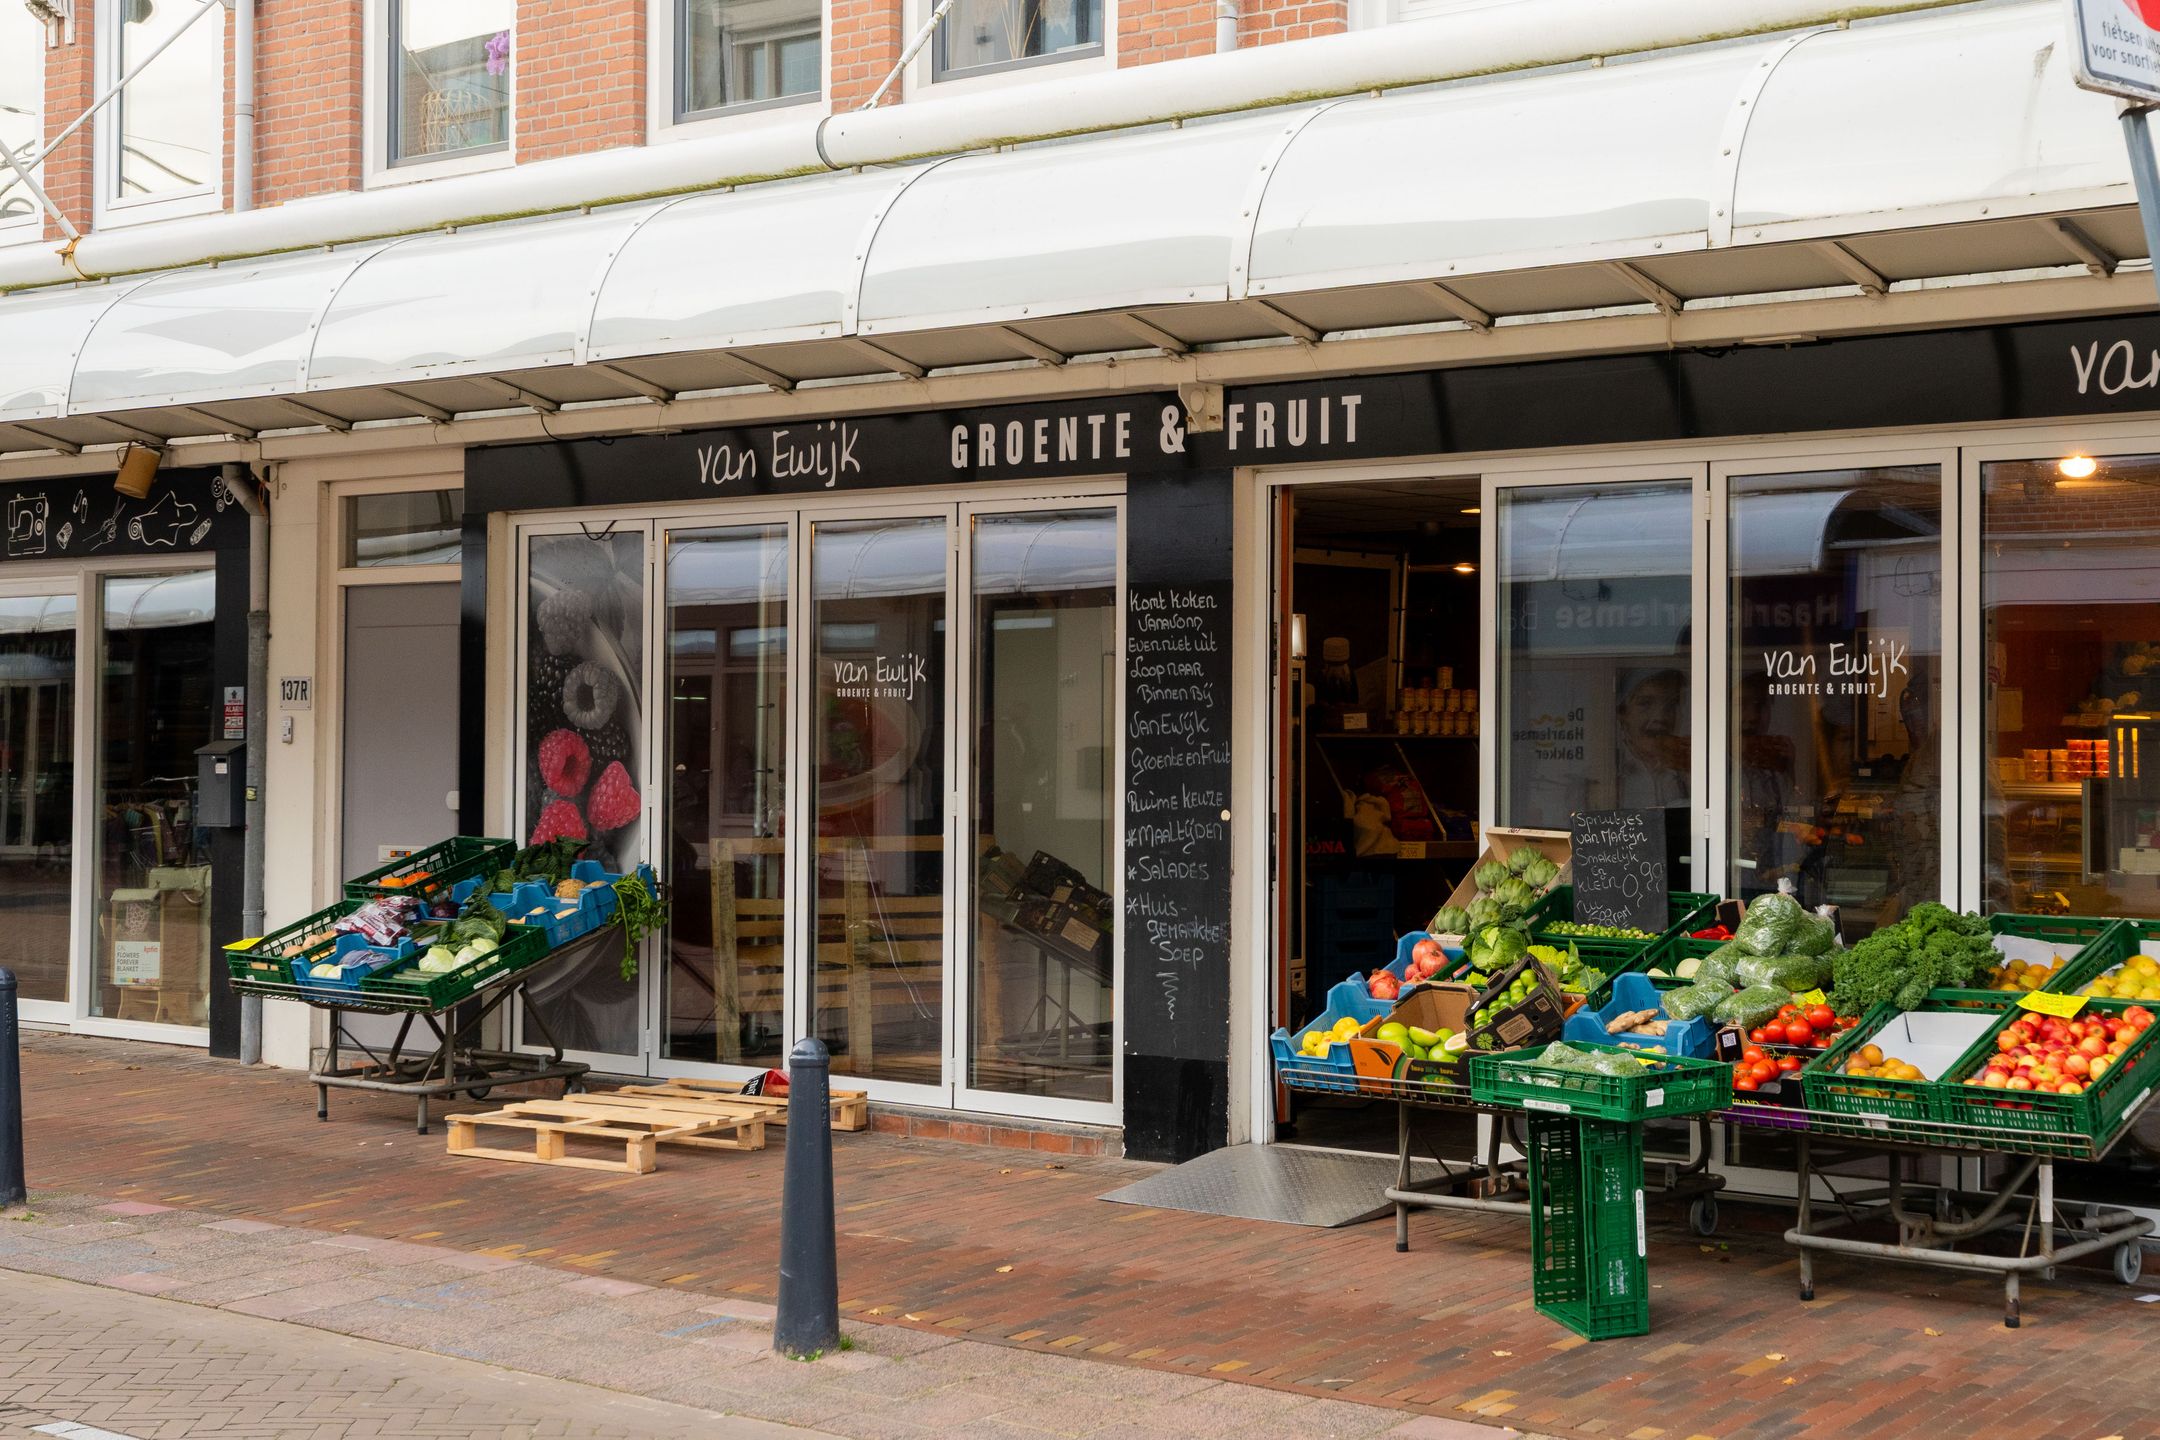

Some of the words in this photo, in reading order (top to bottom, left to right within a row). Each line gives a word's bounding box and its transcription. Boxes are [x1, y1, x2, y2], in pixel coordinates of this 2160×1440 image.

[2102, 20, 2142, 47] fietsen
[2092, 43, 2118, 61] voor
[951, 412, 1131, 468] GROENTE
[1160, 404, 1186, 454] &
[1228, 394, 1362, 451] FRUIT
[698, 445, 757, 485] van
[771, 420, 861, 488] Ewijk
[834, 661, 868, 684] van
[876, 652, 926, 701] Ewijk
[1763, 650, 1817, 679] van
[1829, 638, 1908, 698] Ewijk
[281, 680, 308, 701] 137R
[836, 688, 871, 698] GROENTE
[873, 687, 880, 698] &
[883, 687, 907, 698] FRUIT
[1768, 683, 1820, 696] GROENTE
[1826, 682, 1834, 695] &
[1841, 682, 1877, 695] FRUIT
